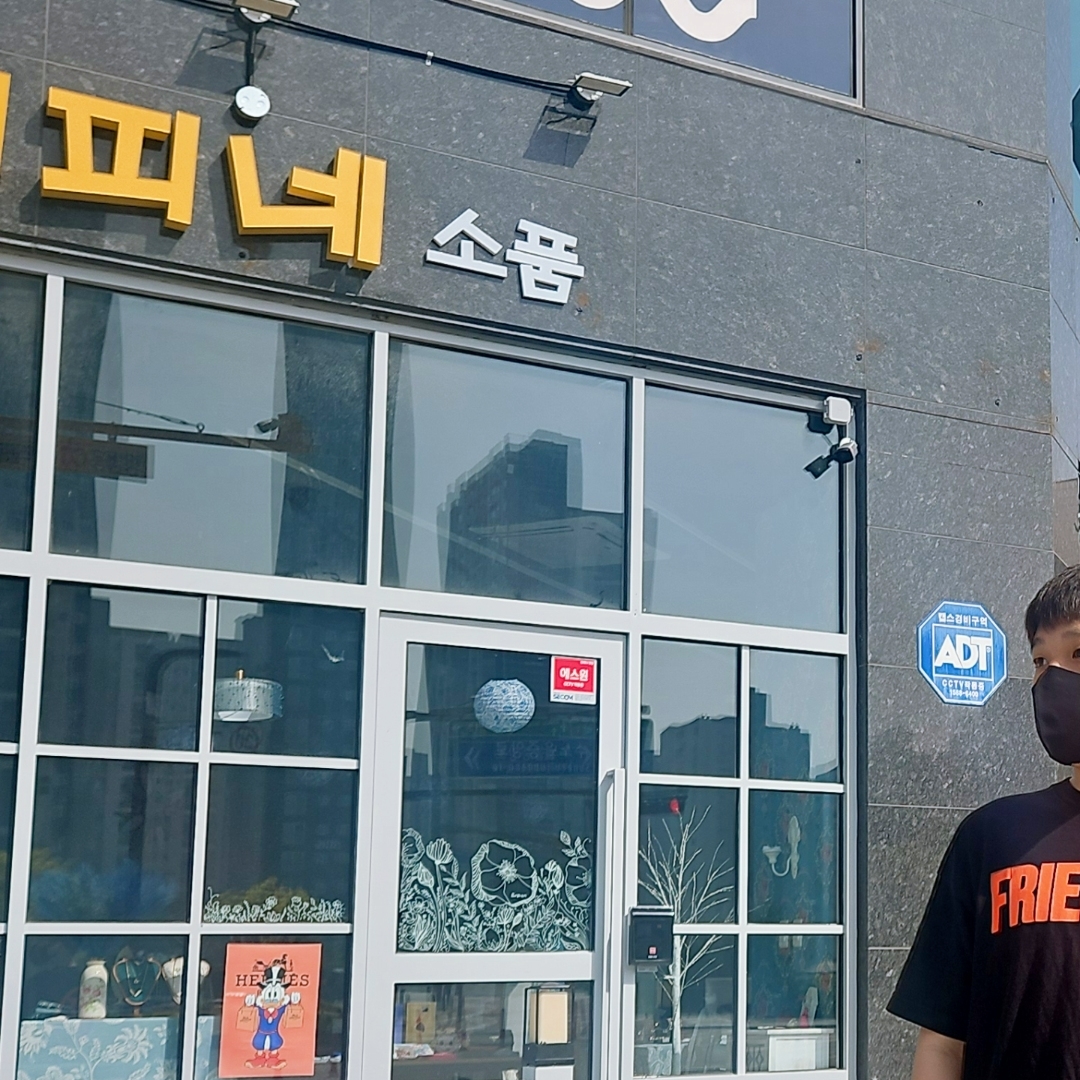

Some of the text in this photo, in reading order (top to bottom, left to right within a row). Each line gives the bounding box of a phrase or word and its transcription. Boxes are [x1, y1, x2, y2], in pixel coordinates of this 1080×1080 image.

[0, 70, 388, 271] 피네
[424, 207, 585, 304] 소품
[559, 667, 589, 682] 에스원
[933, 633, 992, 672] ADT
